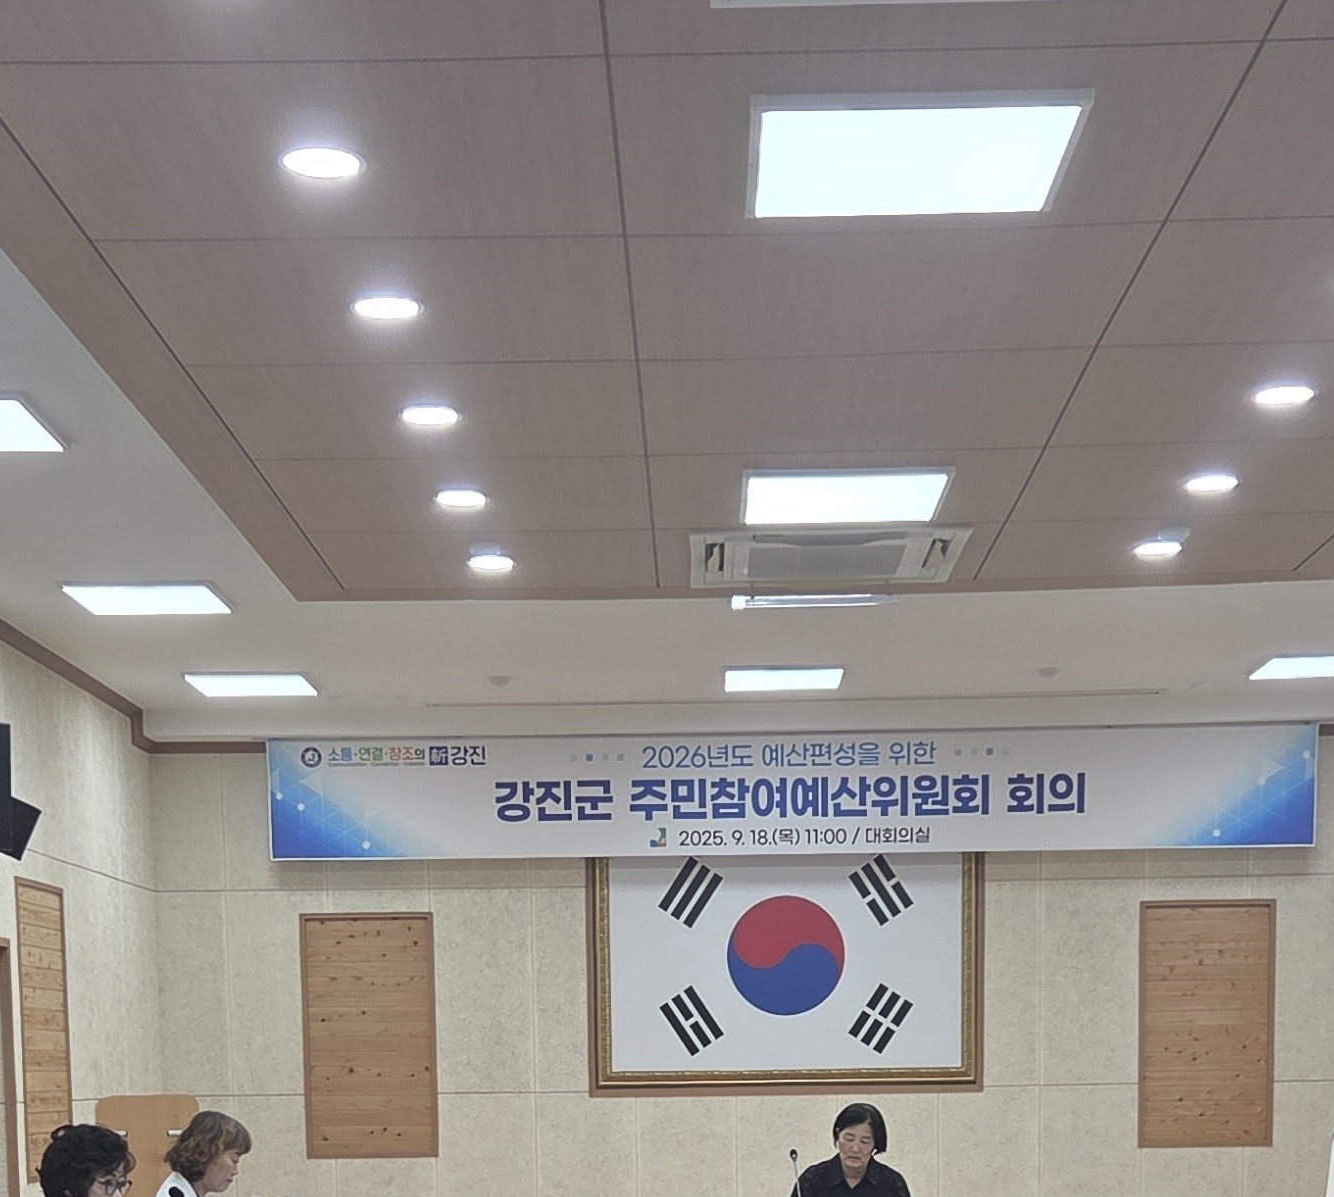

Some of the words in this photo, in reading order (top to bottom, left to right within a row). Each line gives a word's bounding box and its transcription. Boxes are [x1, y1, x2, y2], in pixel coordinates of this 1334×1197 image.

[642, 744, 754, 769] 2026년도
[761, 741, 880, 768] 예산편성을
[889, 741, 936, 766] 위한
[495, 780, 613, 822] 강진군
[629, 774, 990, 821] 주민참여예산위원회
[1006, 772, 1086, 815] 회의
[866, 826, 931, 845] 대회의실
